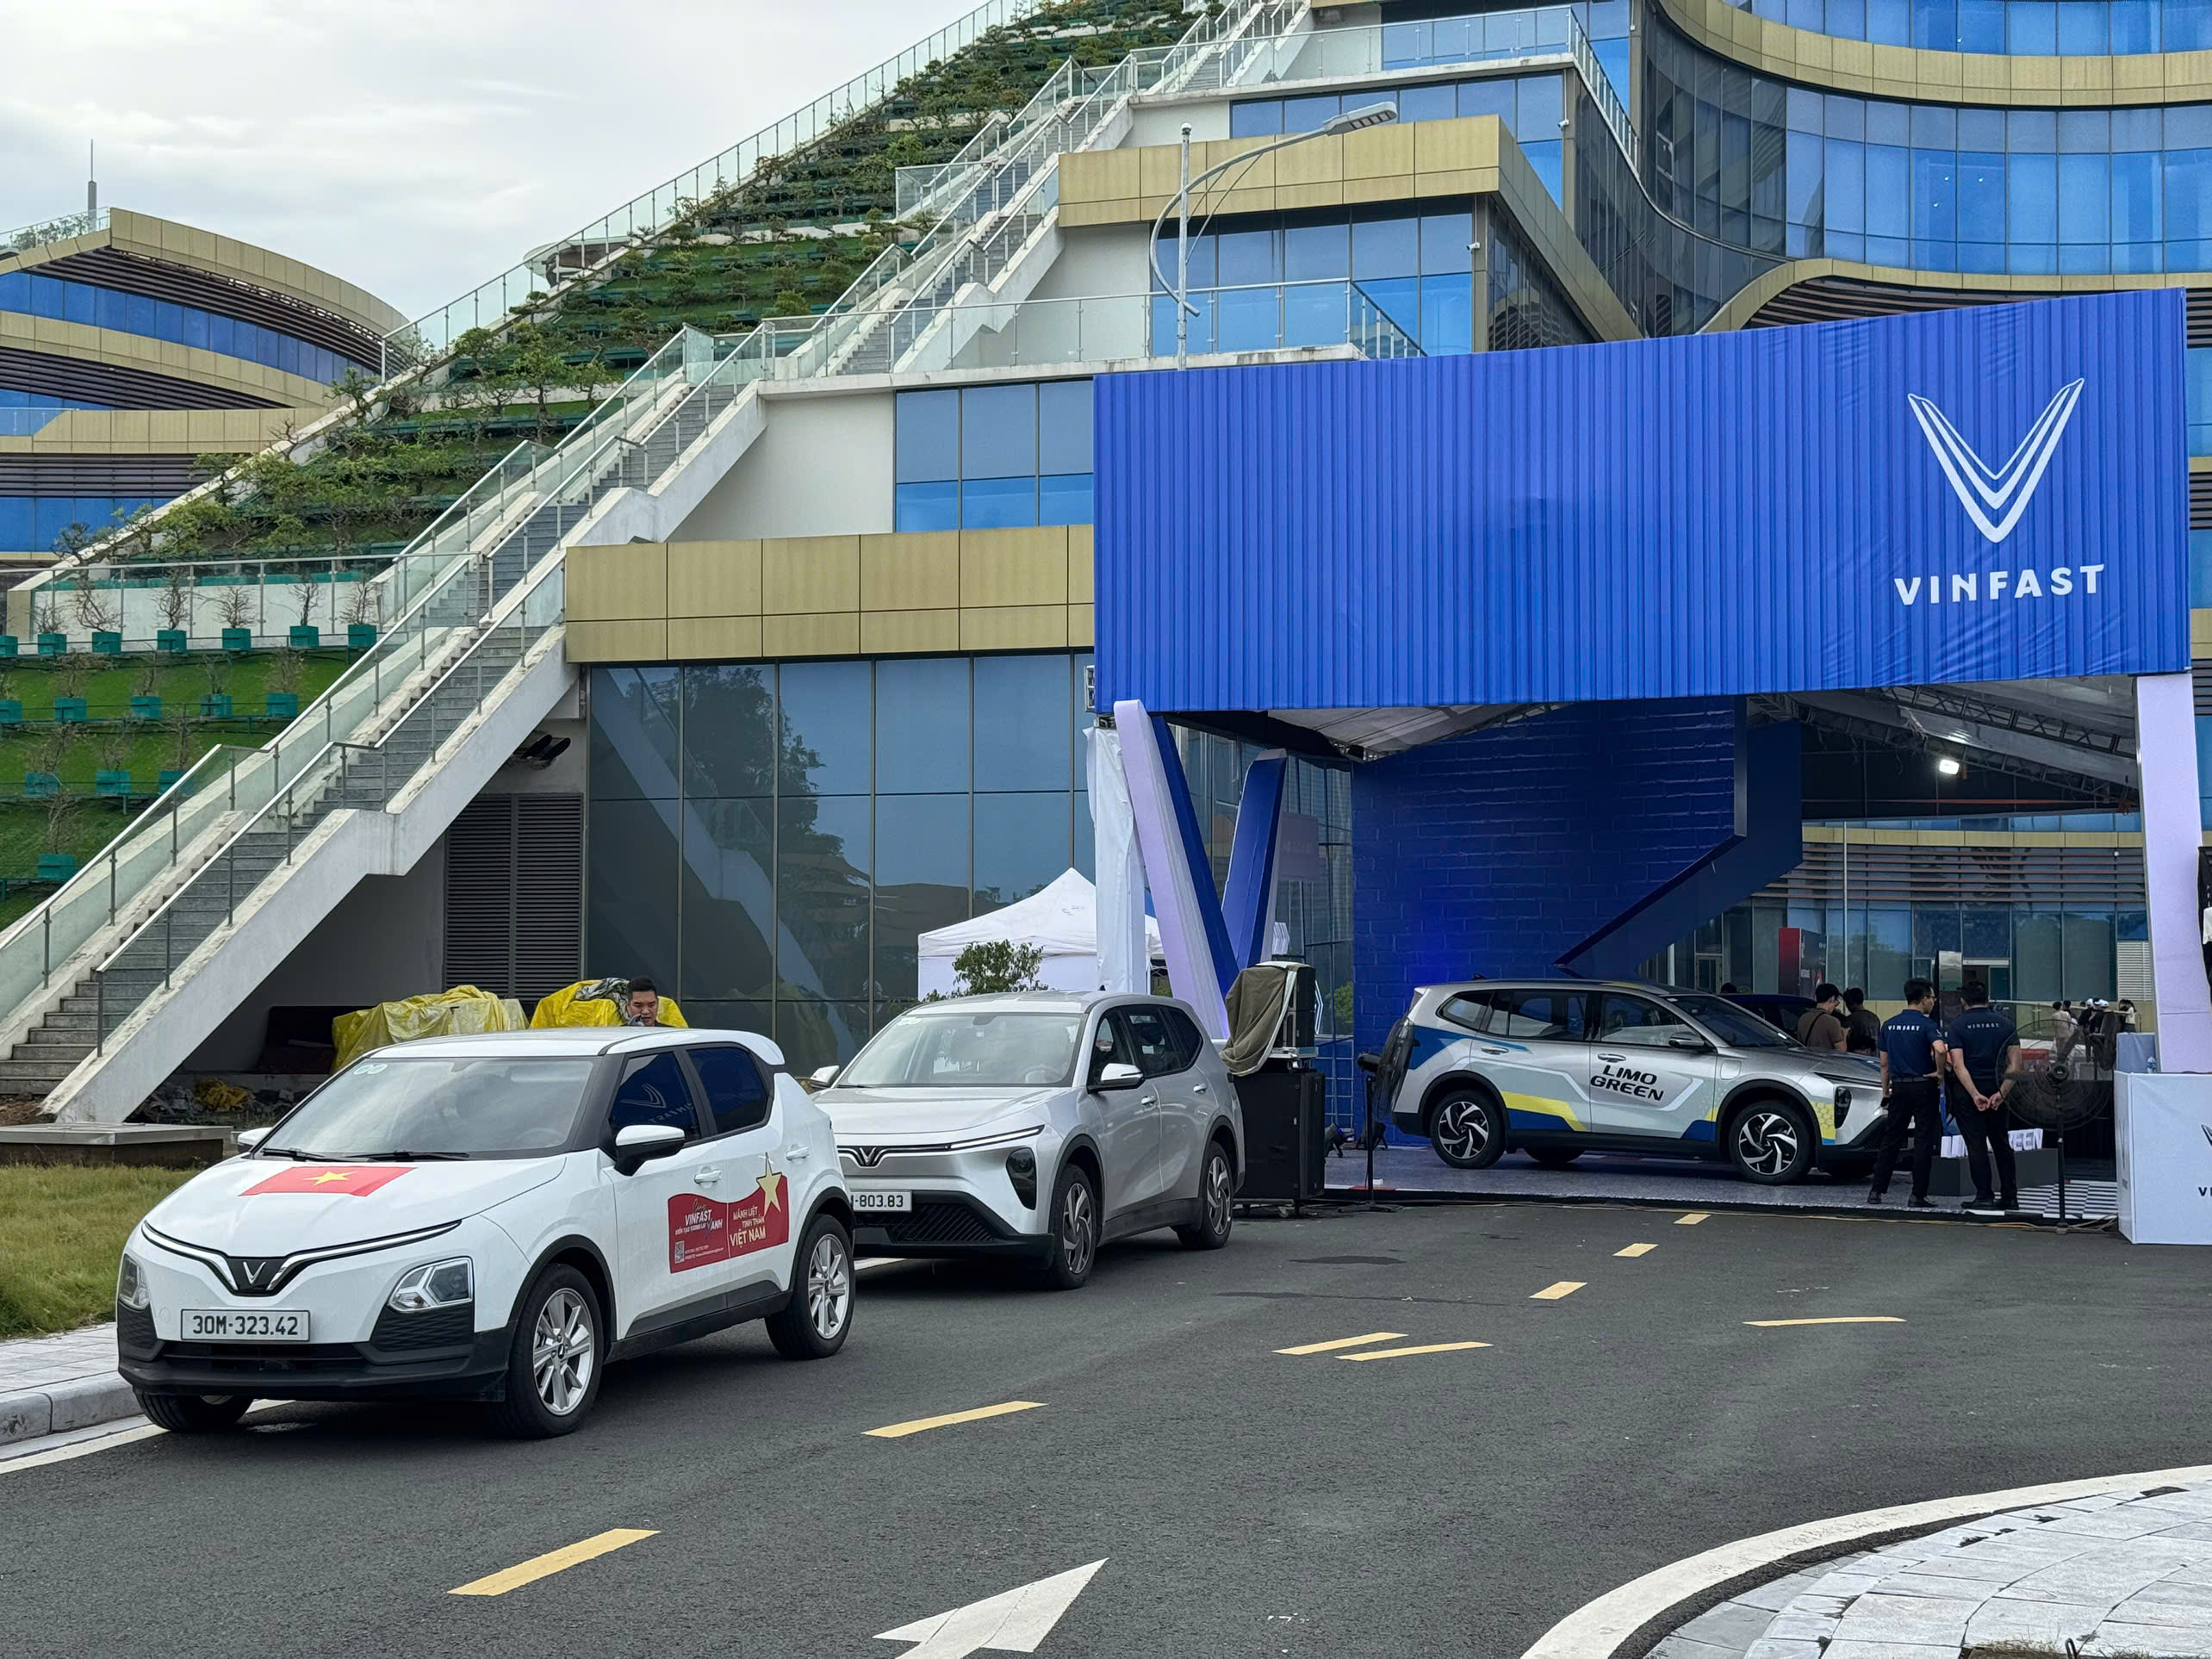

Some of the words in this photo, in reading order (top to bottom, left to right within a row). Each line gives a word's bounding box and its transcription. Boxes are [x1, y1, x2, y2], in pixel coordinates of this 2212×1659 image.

[1894, 564, 2104, 606] VINFAST
[1603, 1065, 1657, 1085] LIMO
[1590, 1075, 1664, 1101] GREEN
[685, 1209, 712, 1226] VINFAST
[730, 1229, 747, 1248] VIỆT
[748, 1227, 766, 1243] NAM
[192, 1315, 298, 1336] 30M-323.42
